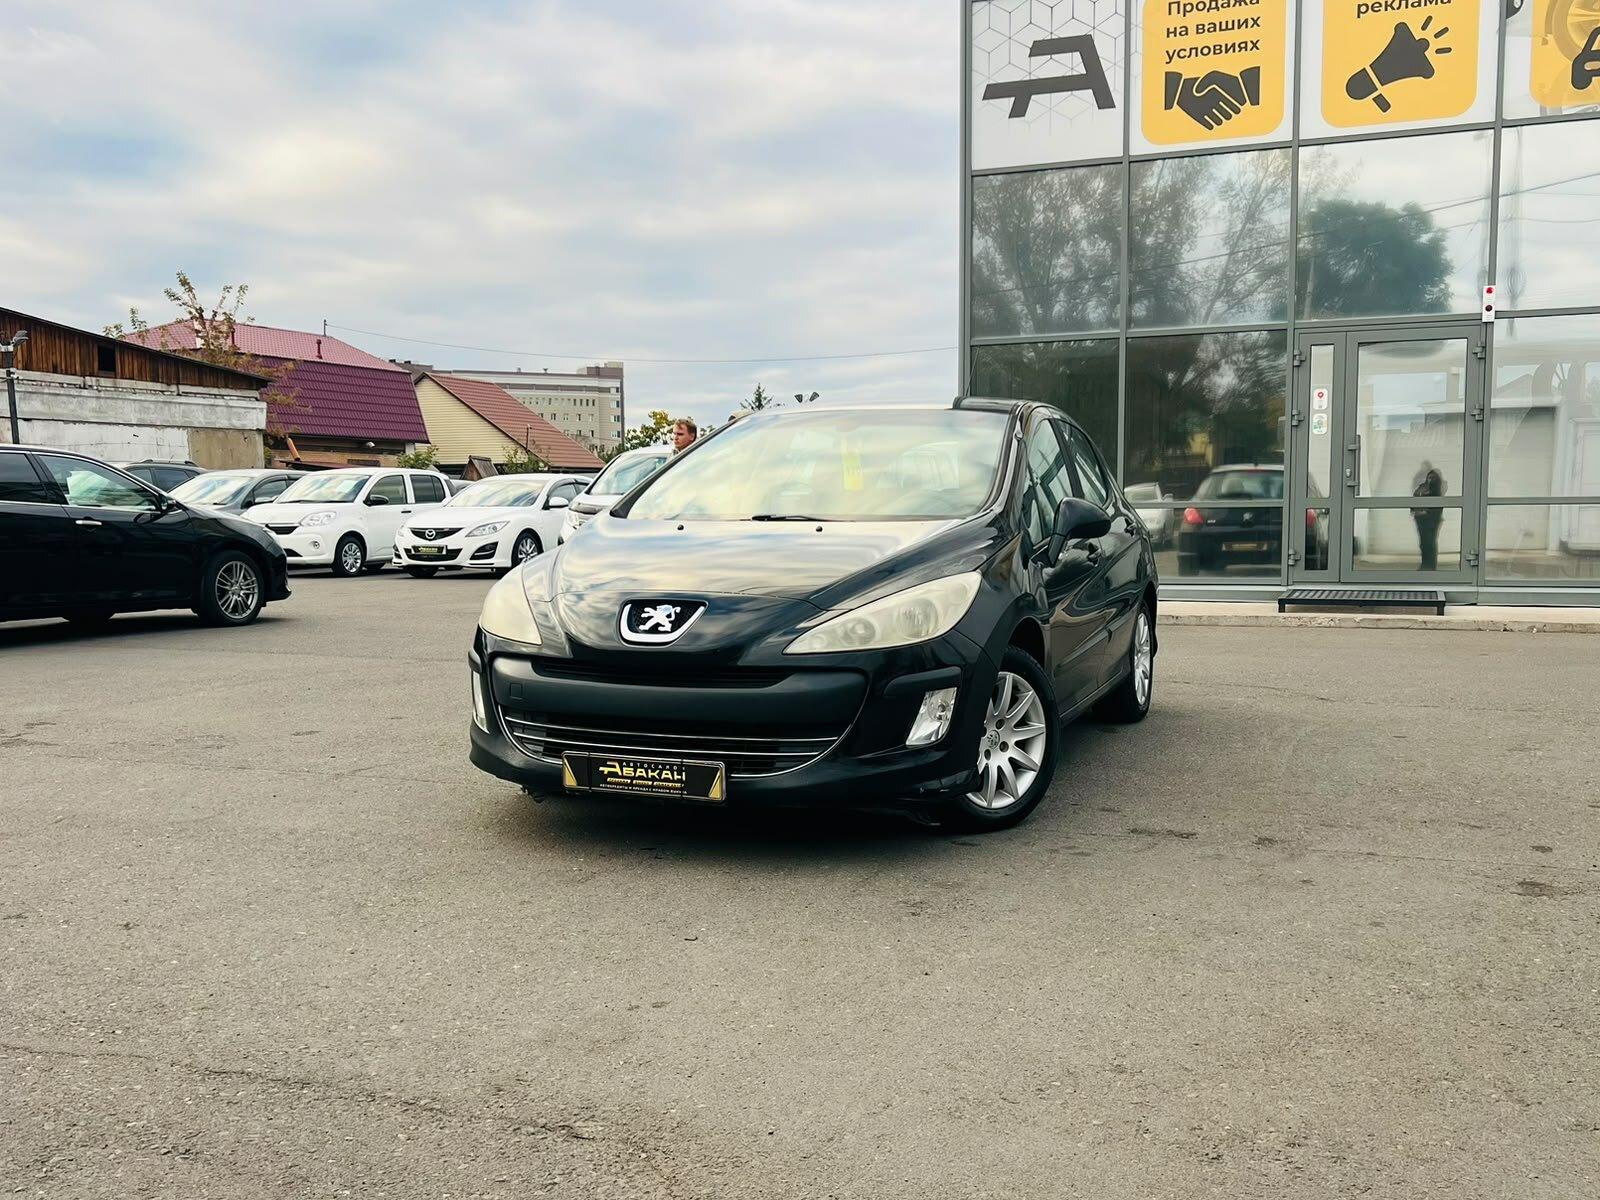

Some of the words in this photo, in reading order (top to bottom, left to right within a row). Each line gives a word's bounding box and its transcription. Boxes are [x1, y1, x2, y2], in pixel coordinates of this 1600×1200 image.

[1166, 25, 1189, 38] на
[1195, 16, 1261, 35] ваших
[1165, 39, 1260, 65] условиях
